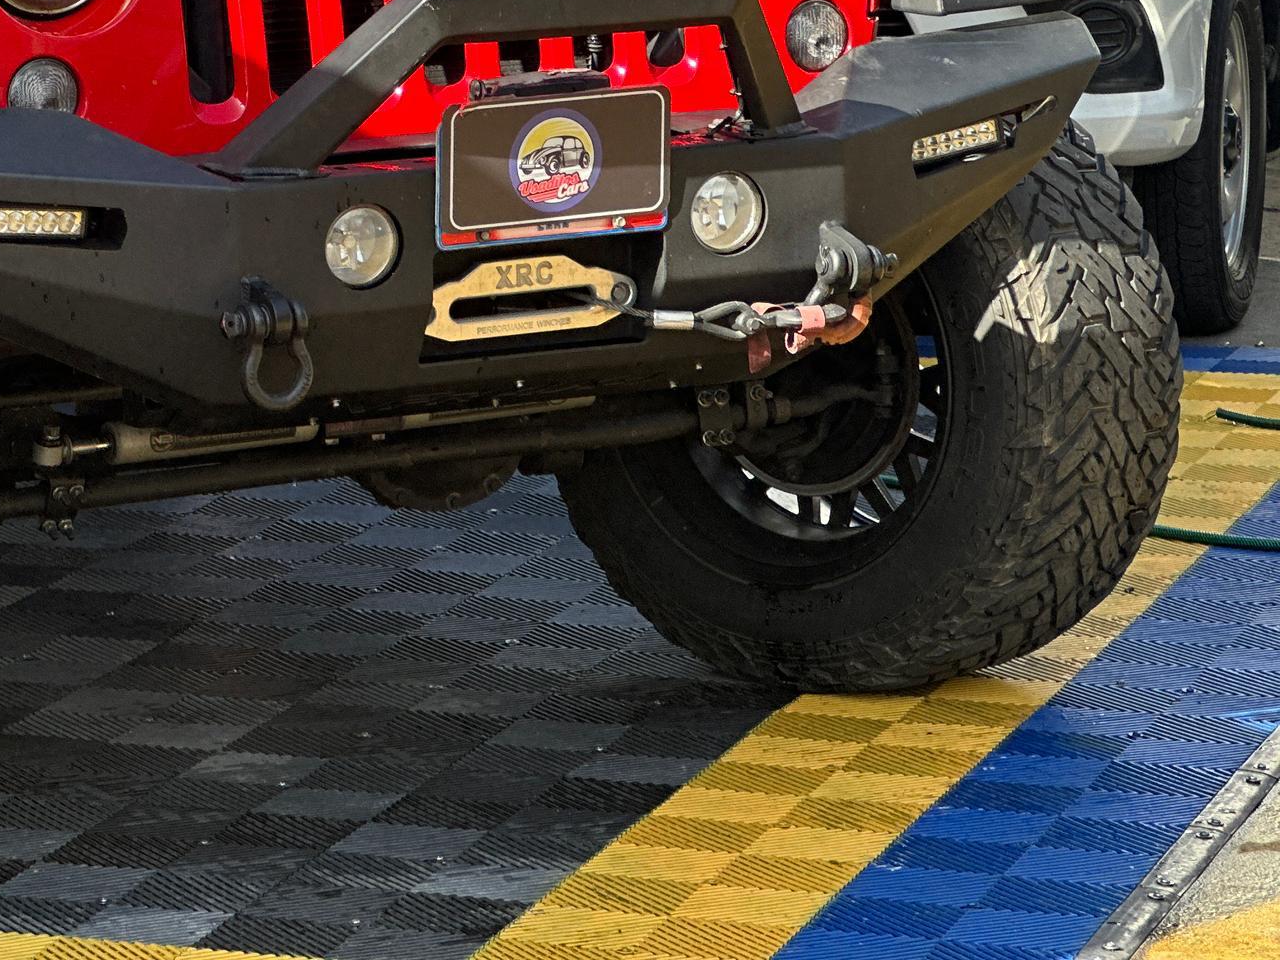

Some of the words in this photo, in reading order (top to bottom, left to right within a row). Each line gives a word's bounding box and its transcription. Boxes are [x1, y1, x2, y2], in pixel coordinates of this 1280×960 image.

[557, 181, 590, 198] Cars
[495, 260, 554, 289] XRC
[476, 320, 534, 335] PERFORMANCE
[536, 316, 572, 329] WINCHES
